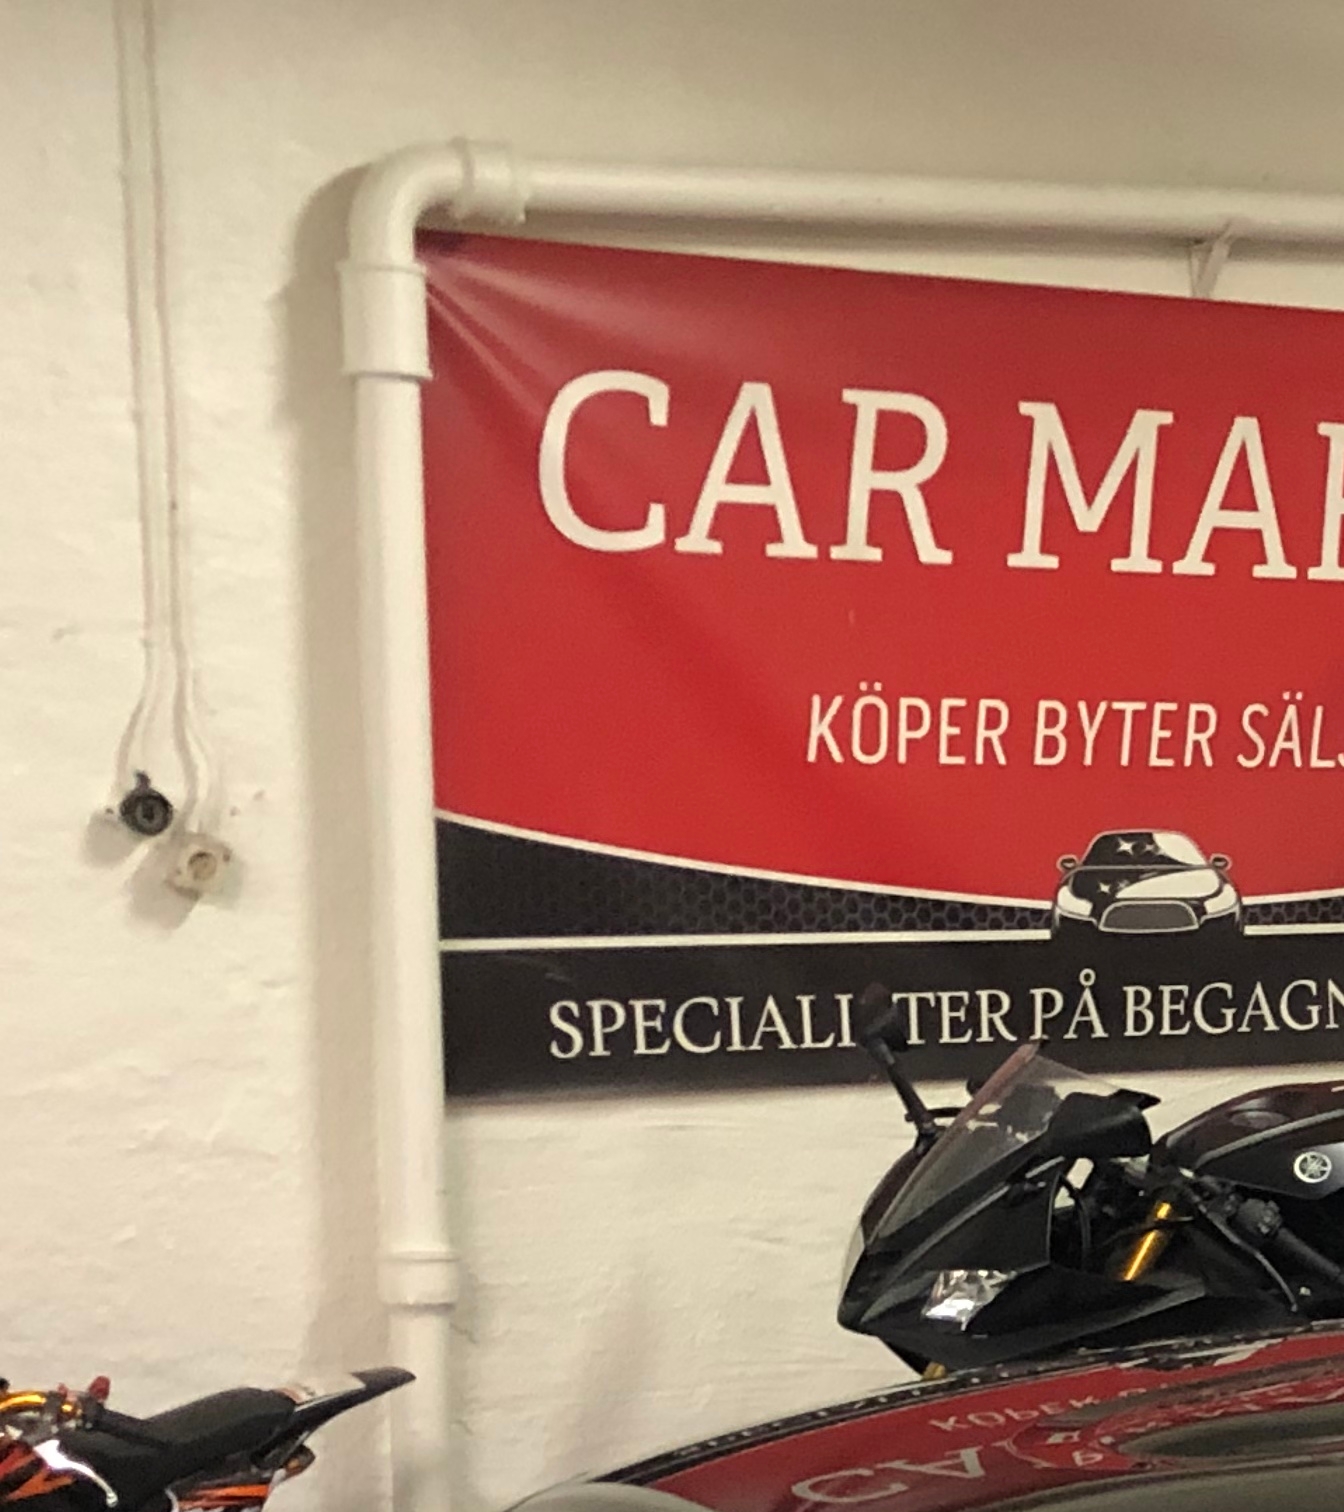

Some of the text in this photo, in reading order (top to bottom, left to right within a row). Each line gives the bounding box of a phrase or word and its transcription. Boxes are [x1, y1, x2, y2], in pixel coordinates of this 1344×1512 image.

[538, 369, 953, 565] CAR
[807, 681, 1008, 766] KÖPER
[1033, 699, 1217, 767] BYTER
[550, 990, 1017, 1060] SPECIALITER
[1029, 968, 1109, 1040] PÅ
